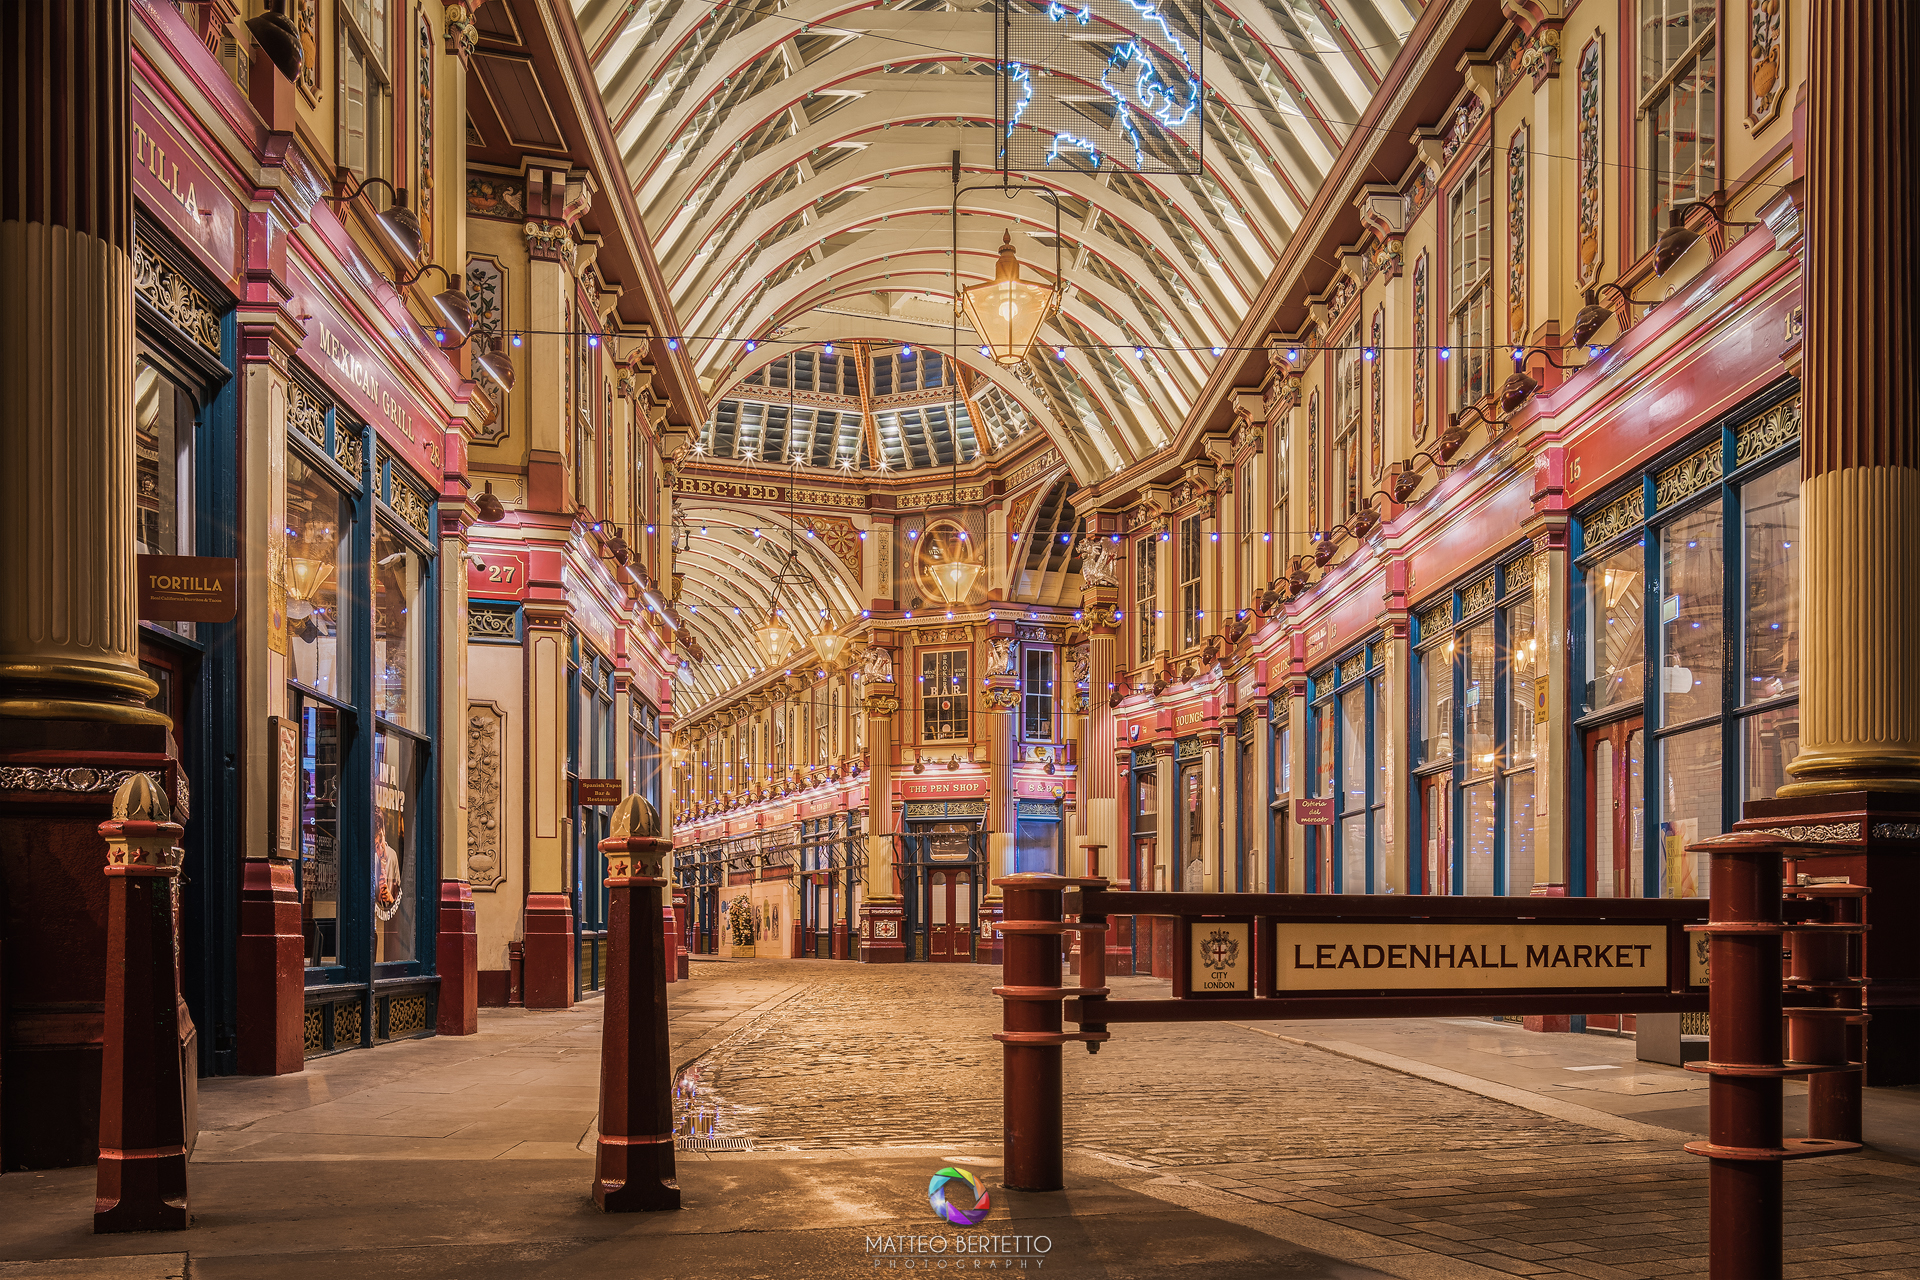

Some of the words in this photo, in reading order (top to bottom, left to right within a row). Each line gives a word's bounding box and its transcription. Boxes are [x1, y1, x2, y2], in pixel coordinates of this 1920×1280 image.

[133, 121, 201, 225] TILLA
[1784, 304, 1802, 342] 15
[319, 321, 379, 406] MEXICAN
[382, 390, 416, 443] GRILL
[429, 440, 441, 469] 28
[1569, 456, 1582, 484] 15
[149, 575, 223, 592] TORTILLA
[488, 565, 516, 583] 27
[1408, 570, 1416, 589] 14
[930, 684, 961, 696] BAR
[1175, 711, 1204, 727] YOUNGS
[379, 762, 389, 784] IN
[390, 765, 397, 786] A
[909, 786, 927, 794] THE
[930, 784, 950, 792] PEN
[953, 783, 980, 792] SHOP
[1028, 784, 1035, 792] 8
[1046, 784, 1052, 792] 9
[375, 785, 406, 813] URRY?
[1294, 944, 1518, 969] LEADENHALL
[1525, 944, 1652, 968] MARKET
[1211, 972, 1228, 980] CITY
